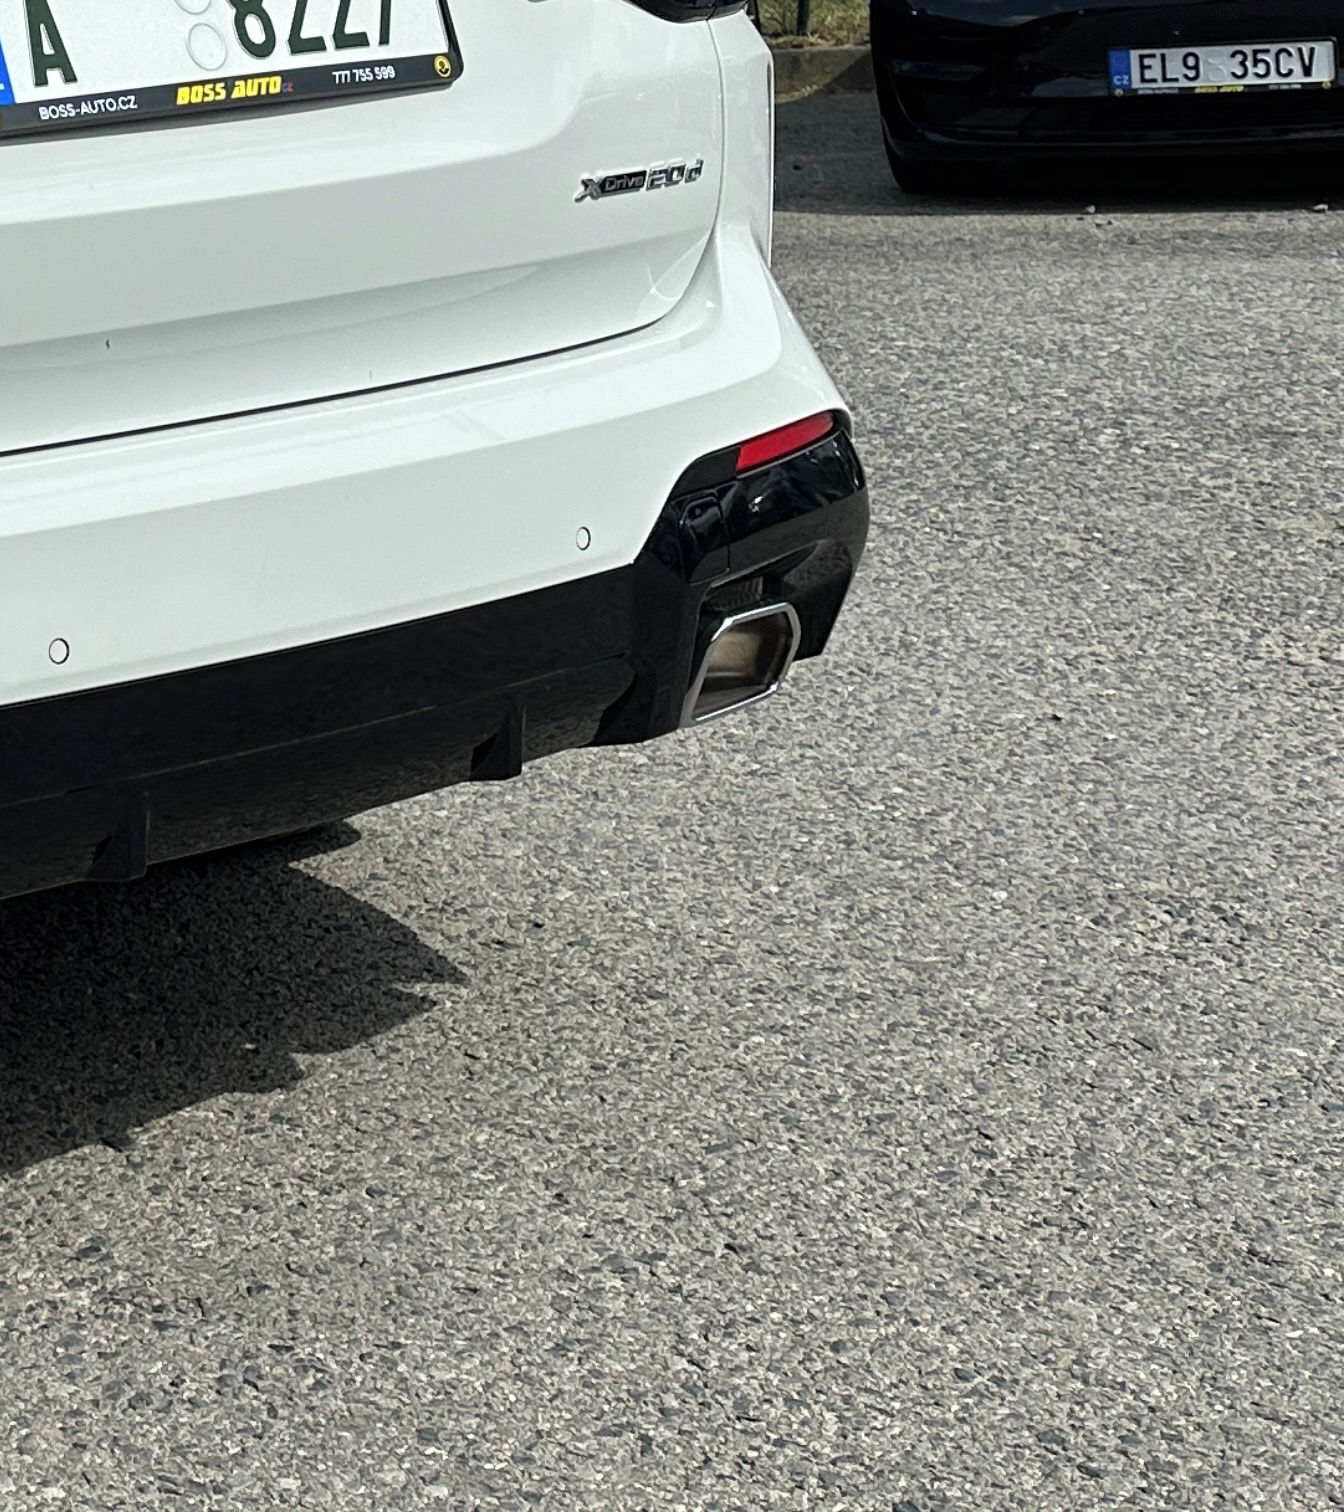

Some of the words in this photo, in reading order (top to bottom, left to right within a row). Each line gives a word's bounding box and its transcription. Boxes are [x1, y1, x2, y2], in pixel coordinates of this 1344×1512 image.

[352, 67, 374, 82] 755
[375, 65, 397, 80] 599
[1137, 51, 1201, 84] EL9
[1229, 45, 1317, 80] 35CV
[177, 82, 227, 106] BOSS
[231, 75, 282, 100] AUTO
[1113, 75, 1130, 86] CZ
[38, 95, 138, 120] BOSS-AUTO.CZ
